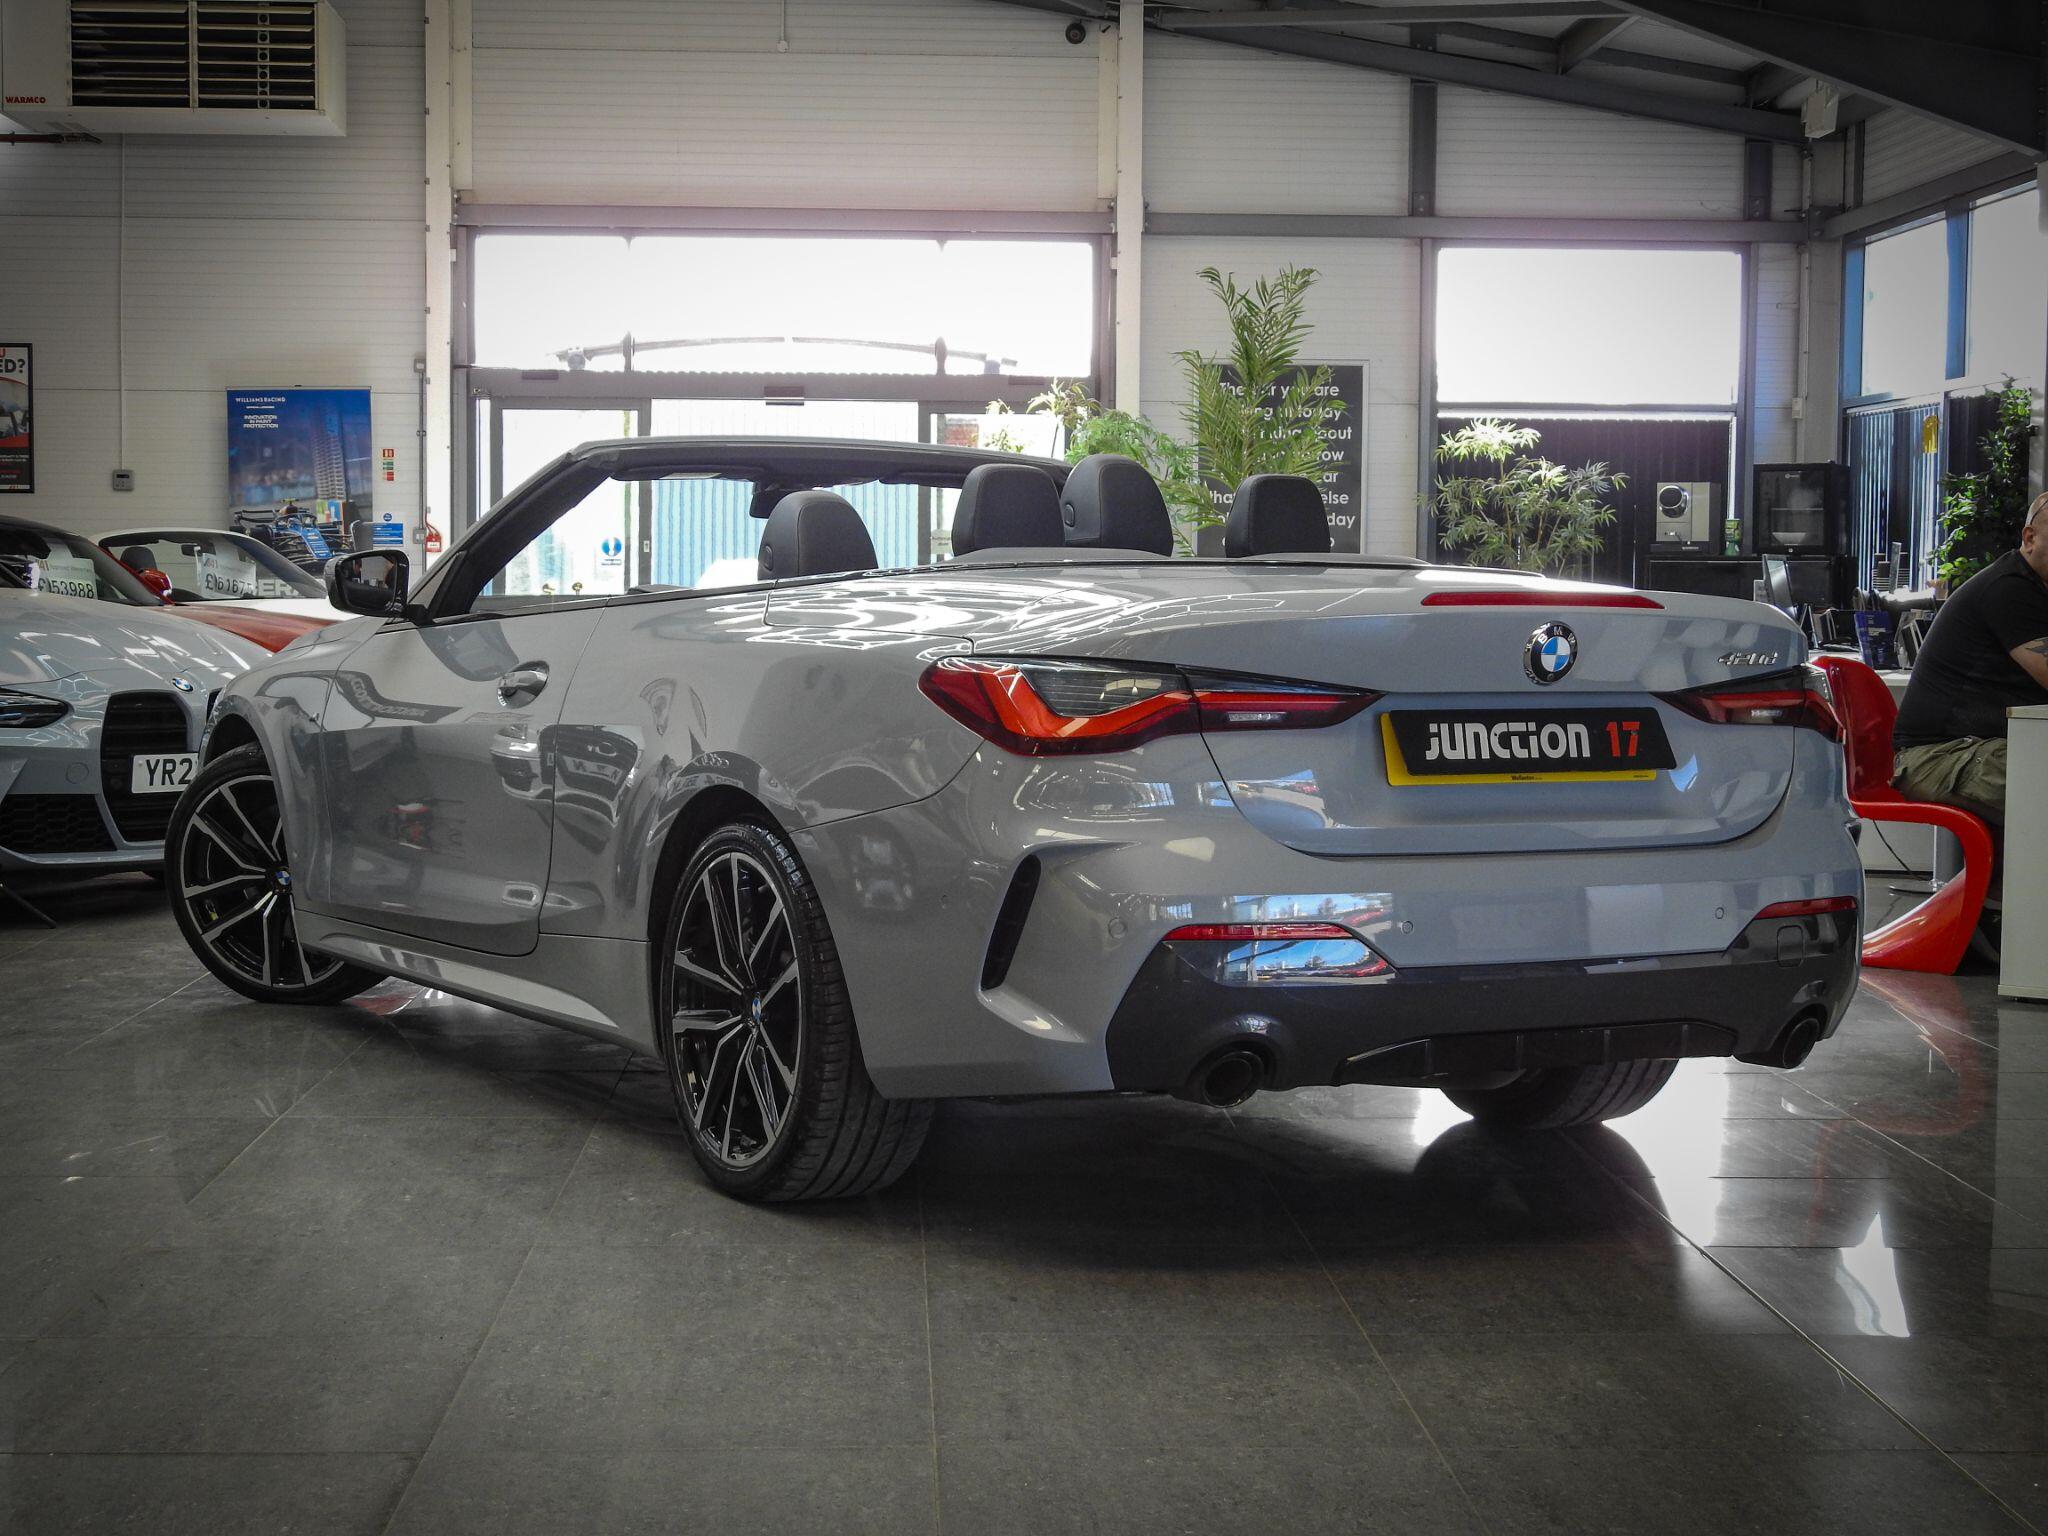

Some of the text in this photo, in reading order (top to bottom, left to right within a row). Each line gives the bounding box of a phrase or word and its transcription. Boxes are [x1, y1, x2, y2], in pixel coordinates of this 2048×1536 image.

[5, 96, 46, 104] WARMCO
[1314, 385, 1340, 397] are
[1321, 490, 1350, 504] else
[1605, 721, 1641, 758] 17
